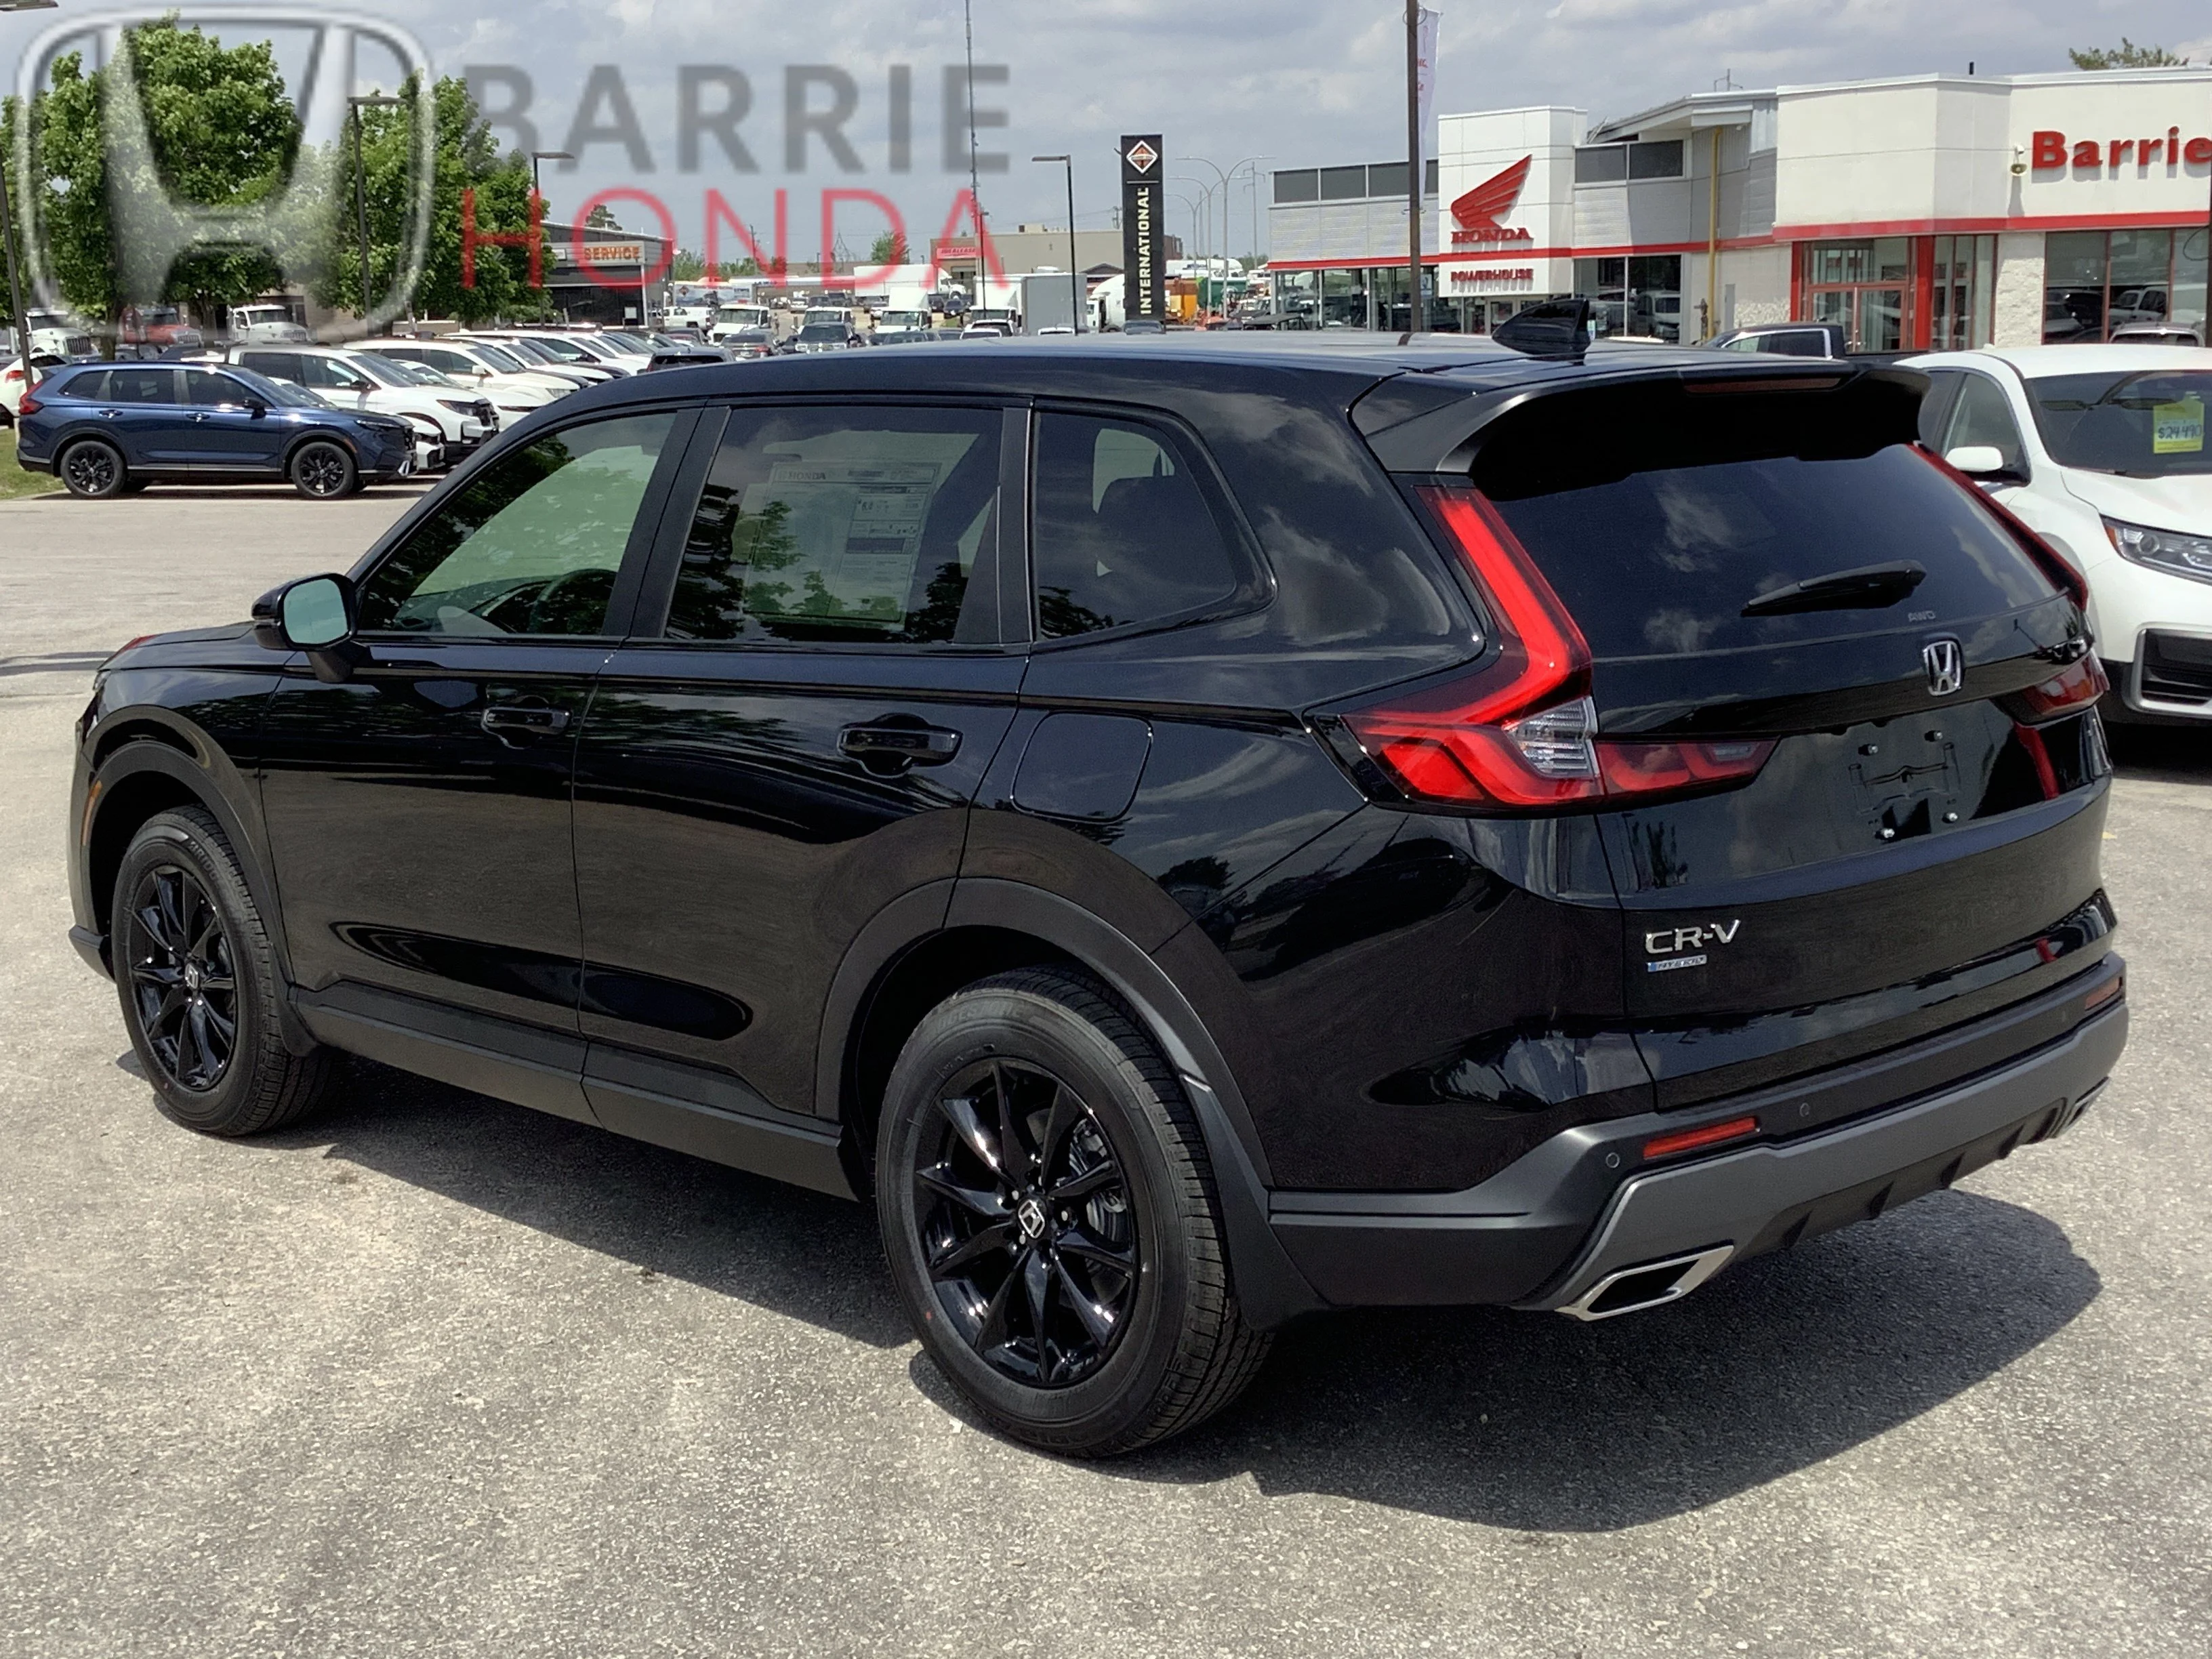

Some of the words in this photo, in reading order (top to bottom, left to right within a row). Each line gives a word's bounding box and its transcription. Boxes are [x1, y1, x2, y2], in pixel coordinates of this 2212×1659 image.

[2032, 126, 2212, 169] Barrie
[1451, 228, 1534, 244] HONDA
[584, 246, 640, 260] SERVICE
[1137, 186, 1152, 314] INTERNATIONAL
[1451, 268, 1534, 282] POWERHOUSE
[787, 472, 826, 480] HONDA
[1908, 610, 1936, 623] AWD
[1645, 919, 1741, 954] CR-V
